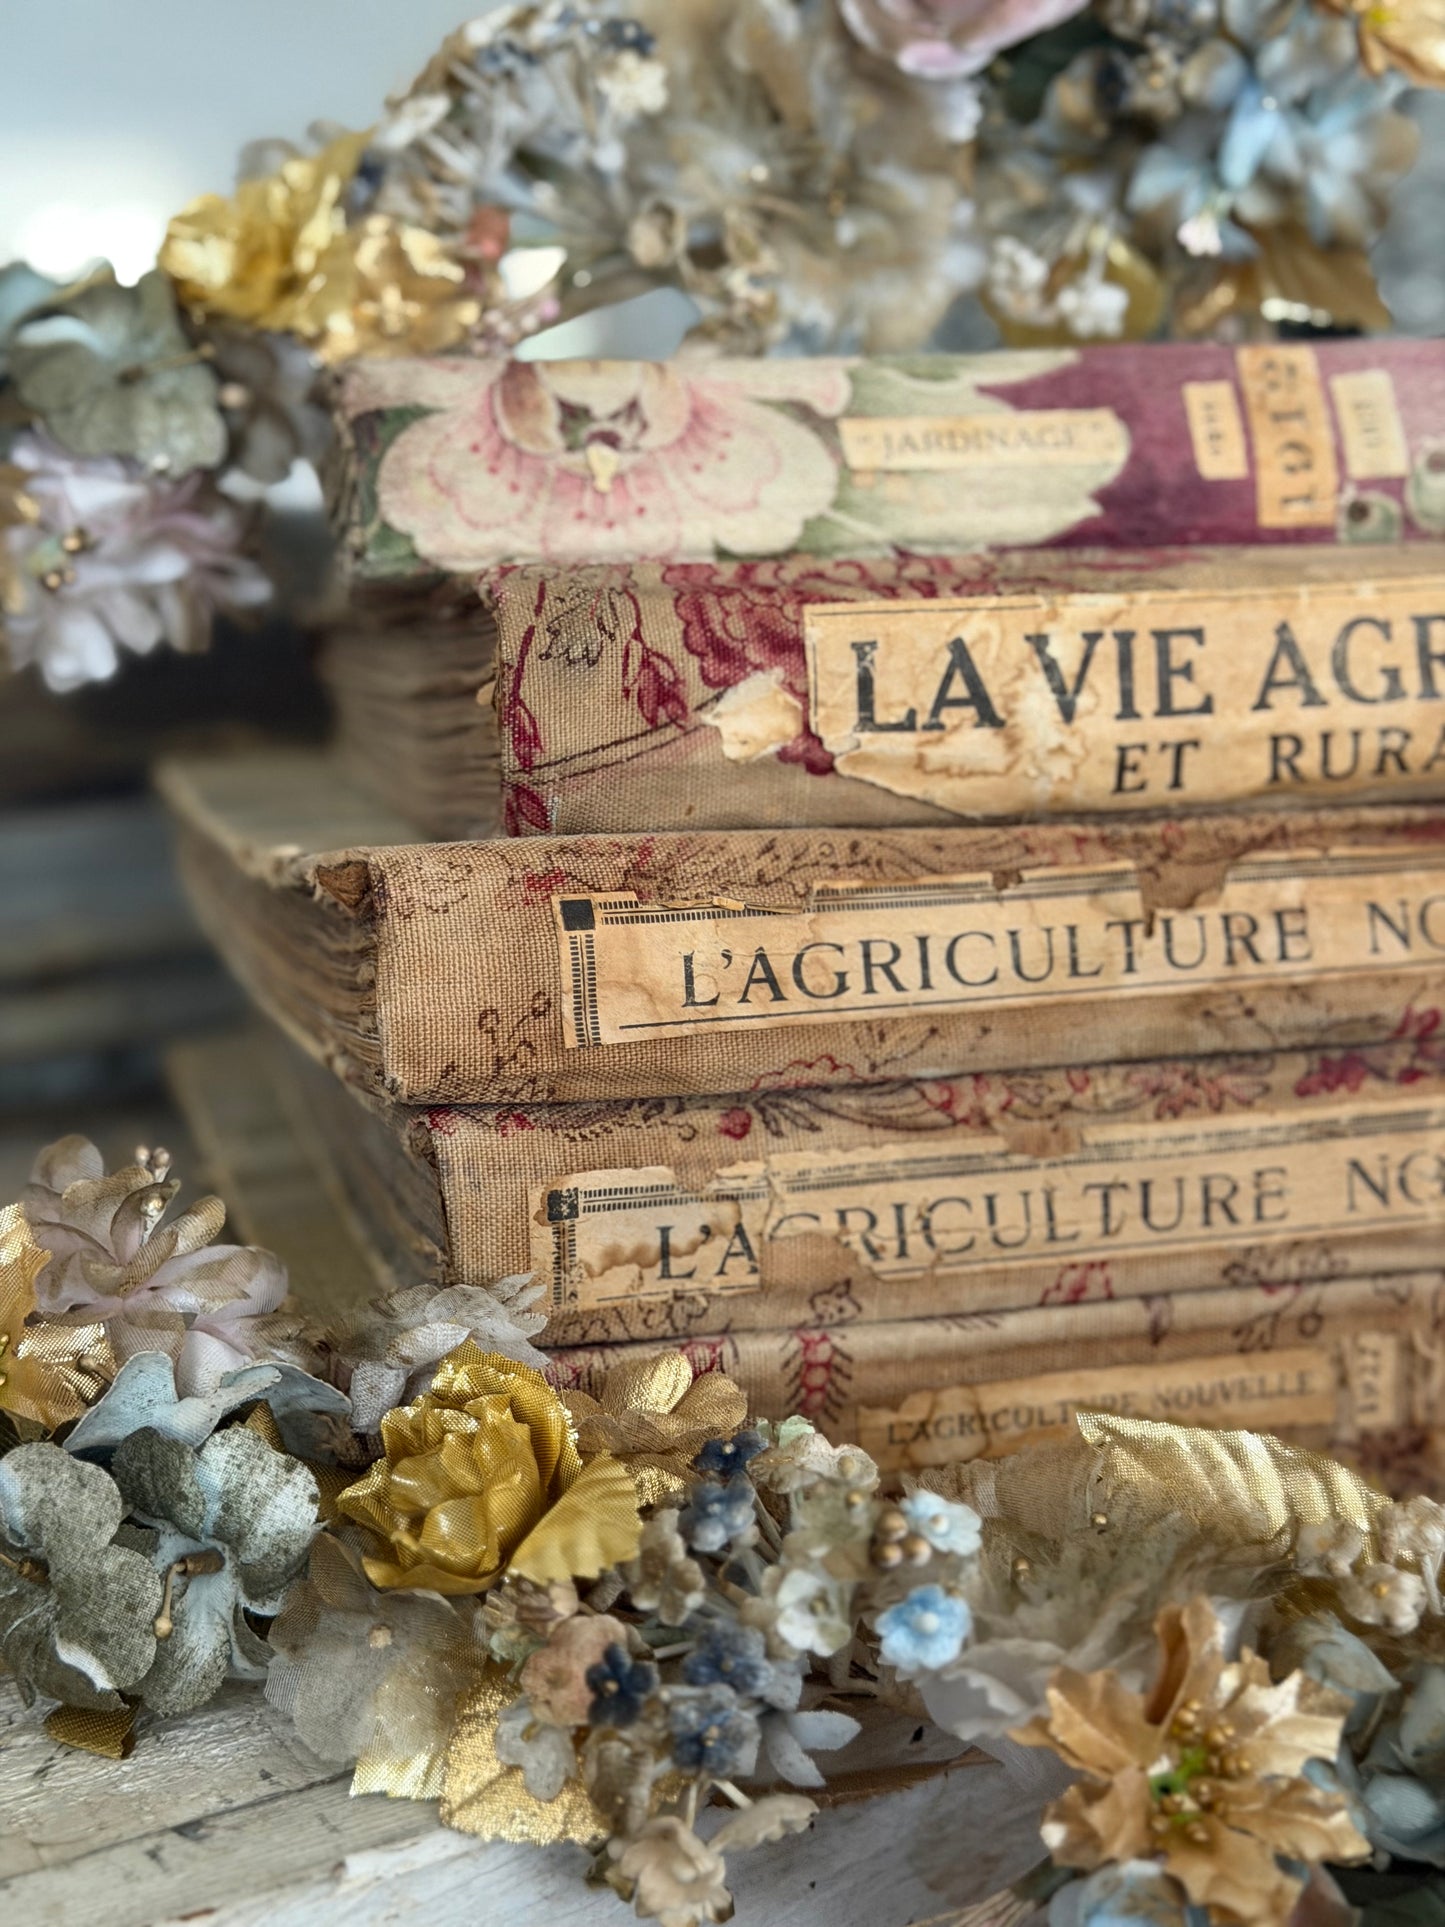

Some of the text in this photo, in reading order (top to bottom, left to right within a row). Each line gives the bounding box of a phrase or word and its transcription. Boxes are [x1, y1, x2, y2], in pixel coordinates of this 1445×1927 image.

[851, 636, 1005, 732] LA
[1023, 626, 1214, 725] VIE
[1112, 739, 1200, 795] ET
[681, 907, 1313, 1007] L'AGRICULTURE
[1152, 1369, 1316, 1416] NOUVELLE
